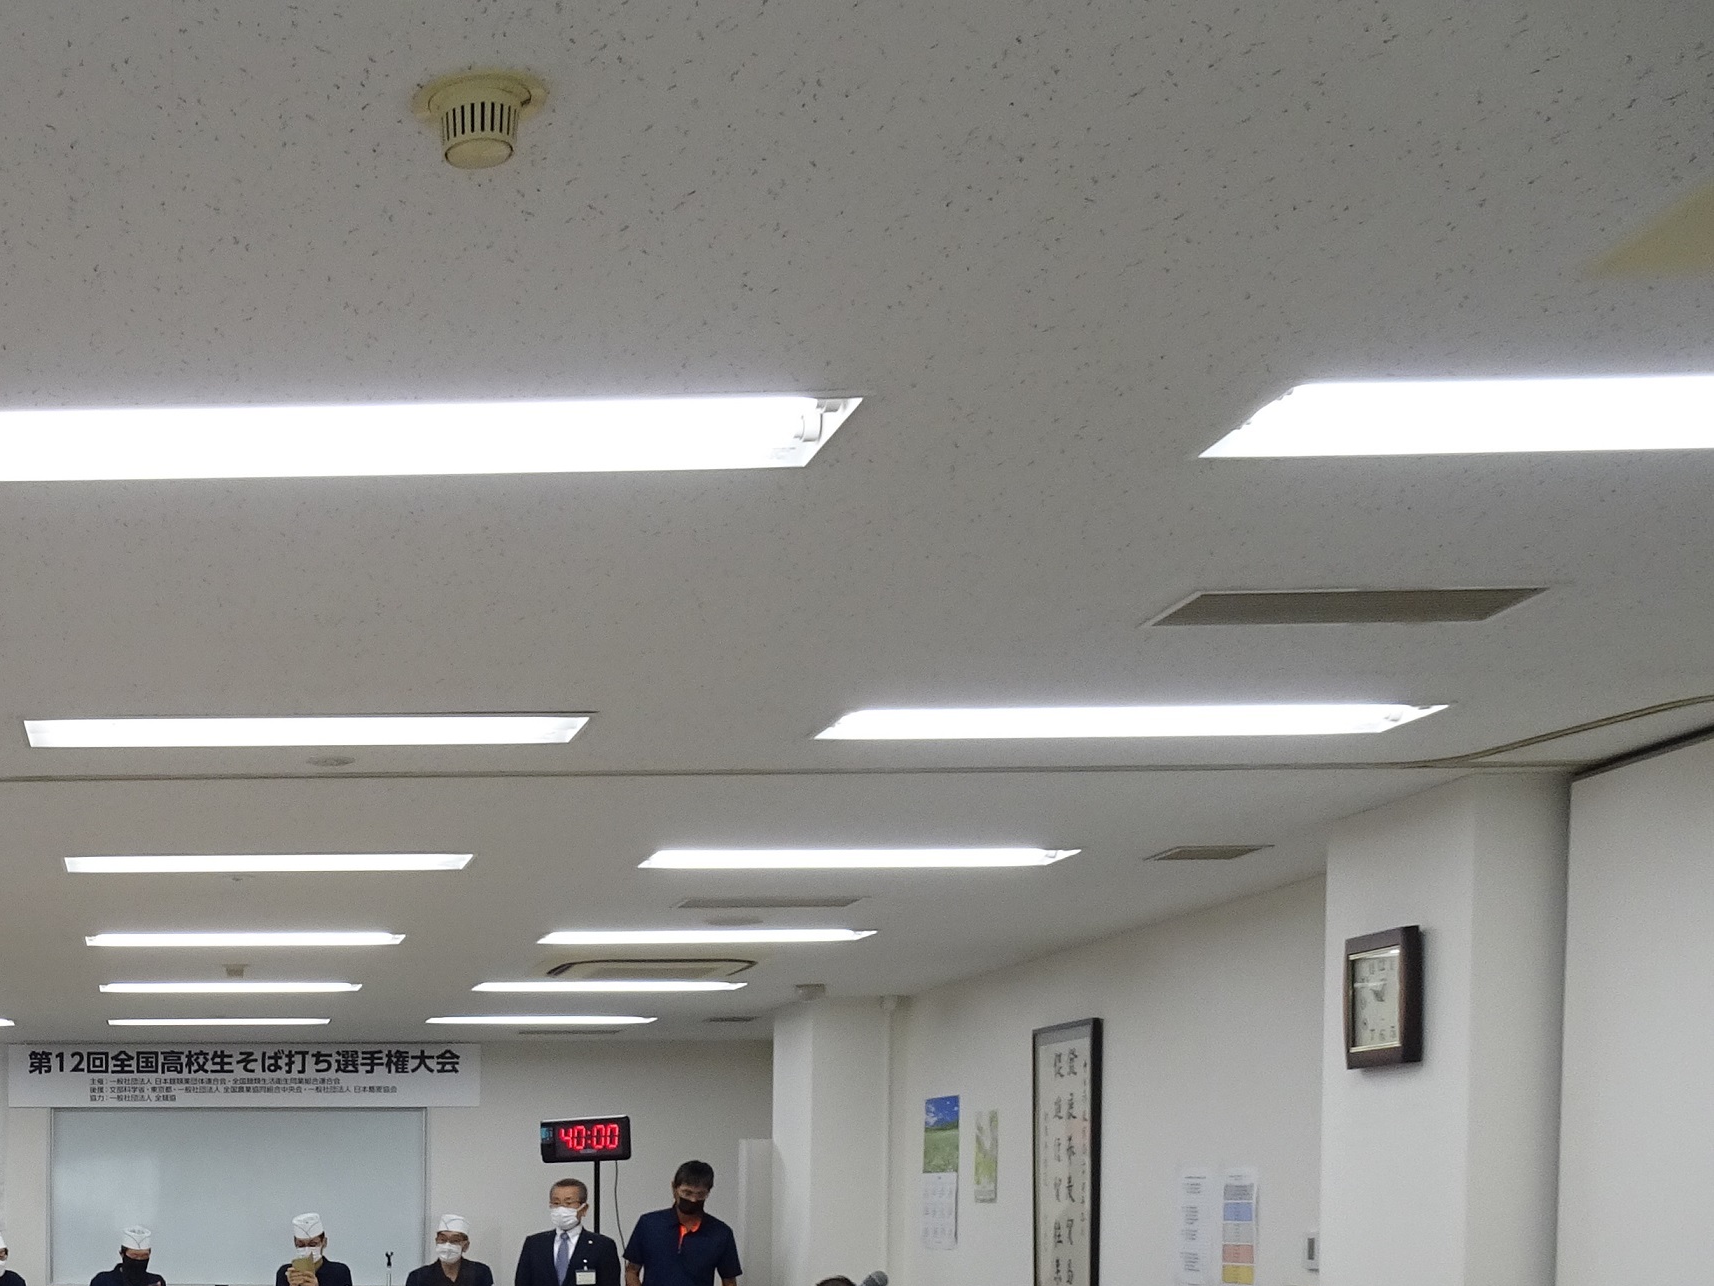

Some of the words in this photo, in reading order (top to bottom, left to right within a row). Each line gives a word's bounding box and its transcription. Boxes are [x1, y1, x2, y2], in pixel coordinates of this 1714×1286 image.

[28, 1050, 461, 1075] 第12回全国高校生そば打ち選手権大会
[559, 1123, 619, 1150] 40:00
